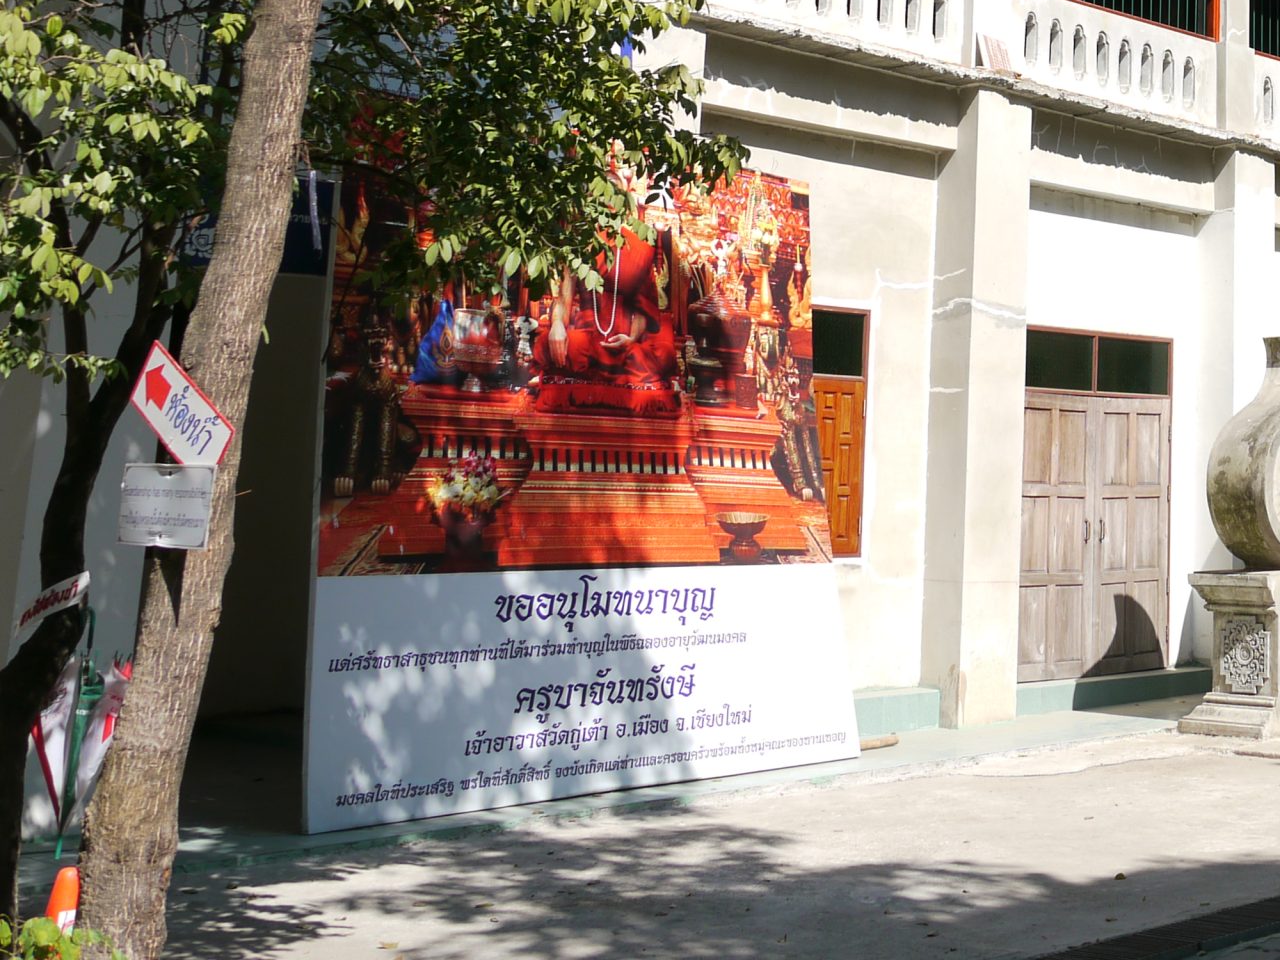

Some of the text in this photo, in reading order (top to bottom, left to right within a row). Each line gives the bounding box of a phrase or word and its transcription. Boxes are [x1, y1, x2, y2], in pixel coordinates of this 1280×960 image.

[165, 385, 219, 455] ห้องน้ำ
[494, 574, 717, 632] ขออนุโมทนาบุญ
[514, 663, 696, 724] ครูบาจันทรังษี
[464, 704, 752, 757] เจ้าอาวาสวัดกู่เต้า อ.เมือง จ.เชียงใหม่
[336, 778, 455, 808] มงคลใดที่ประเสริฐ
